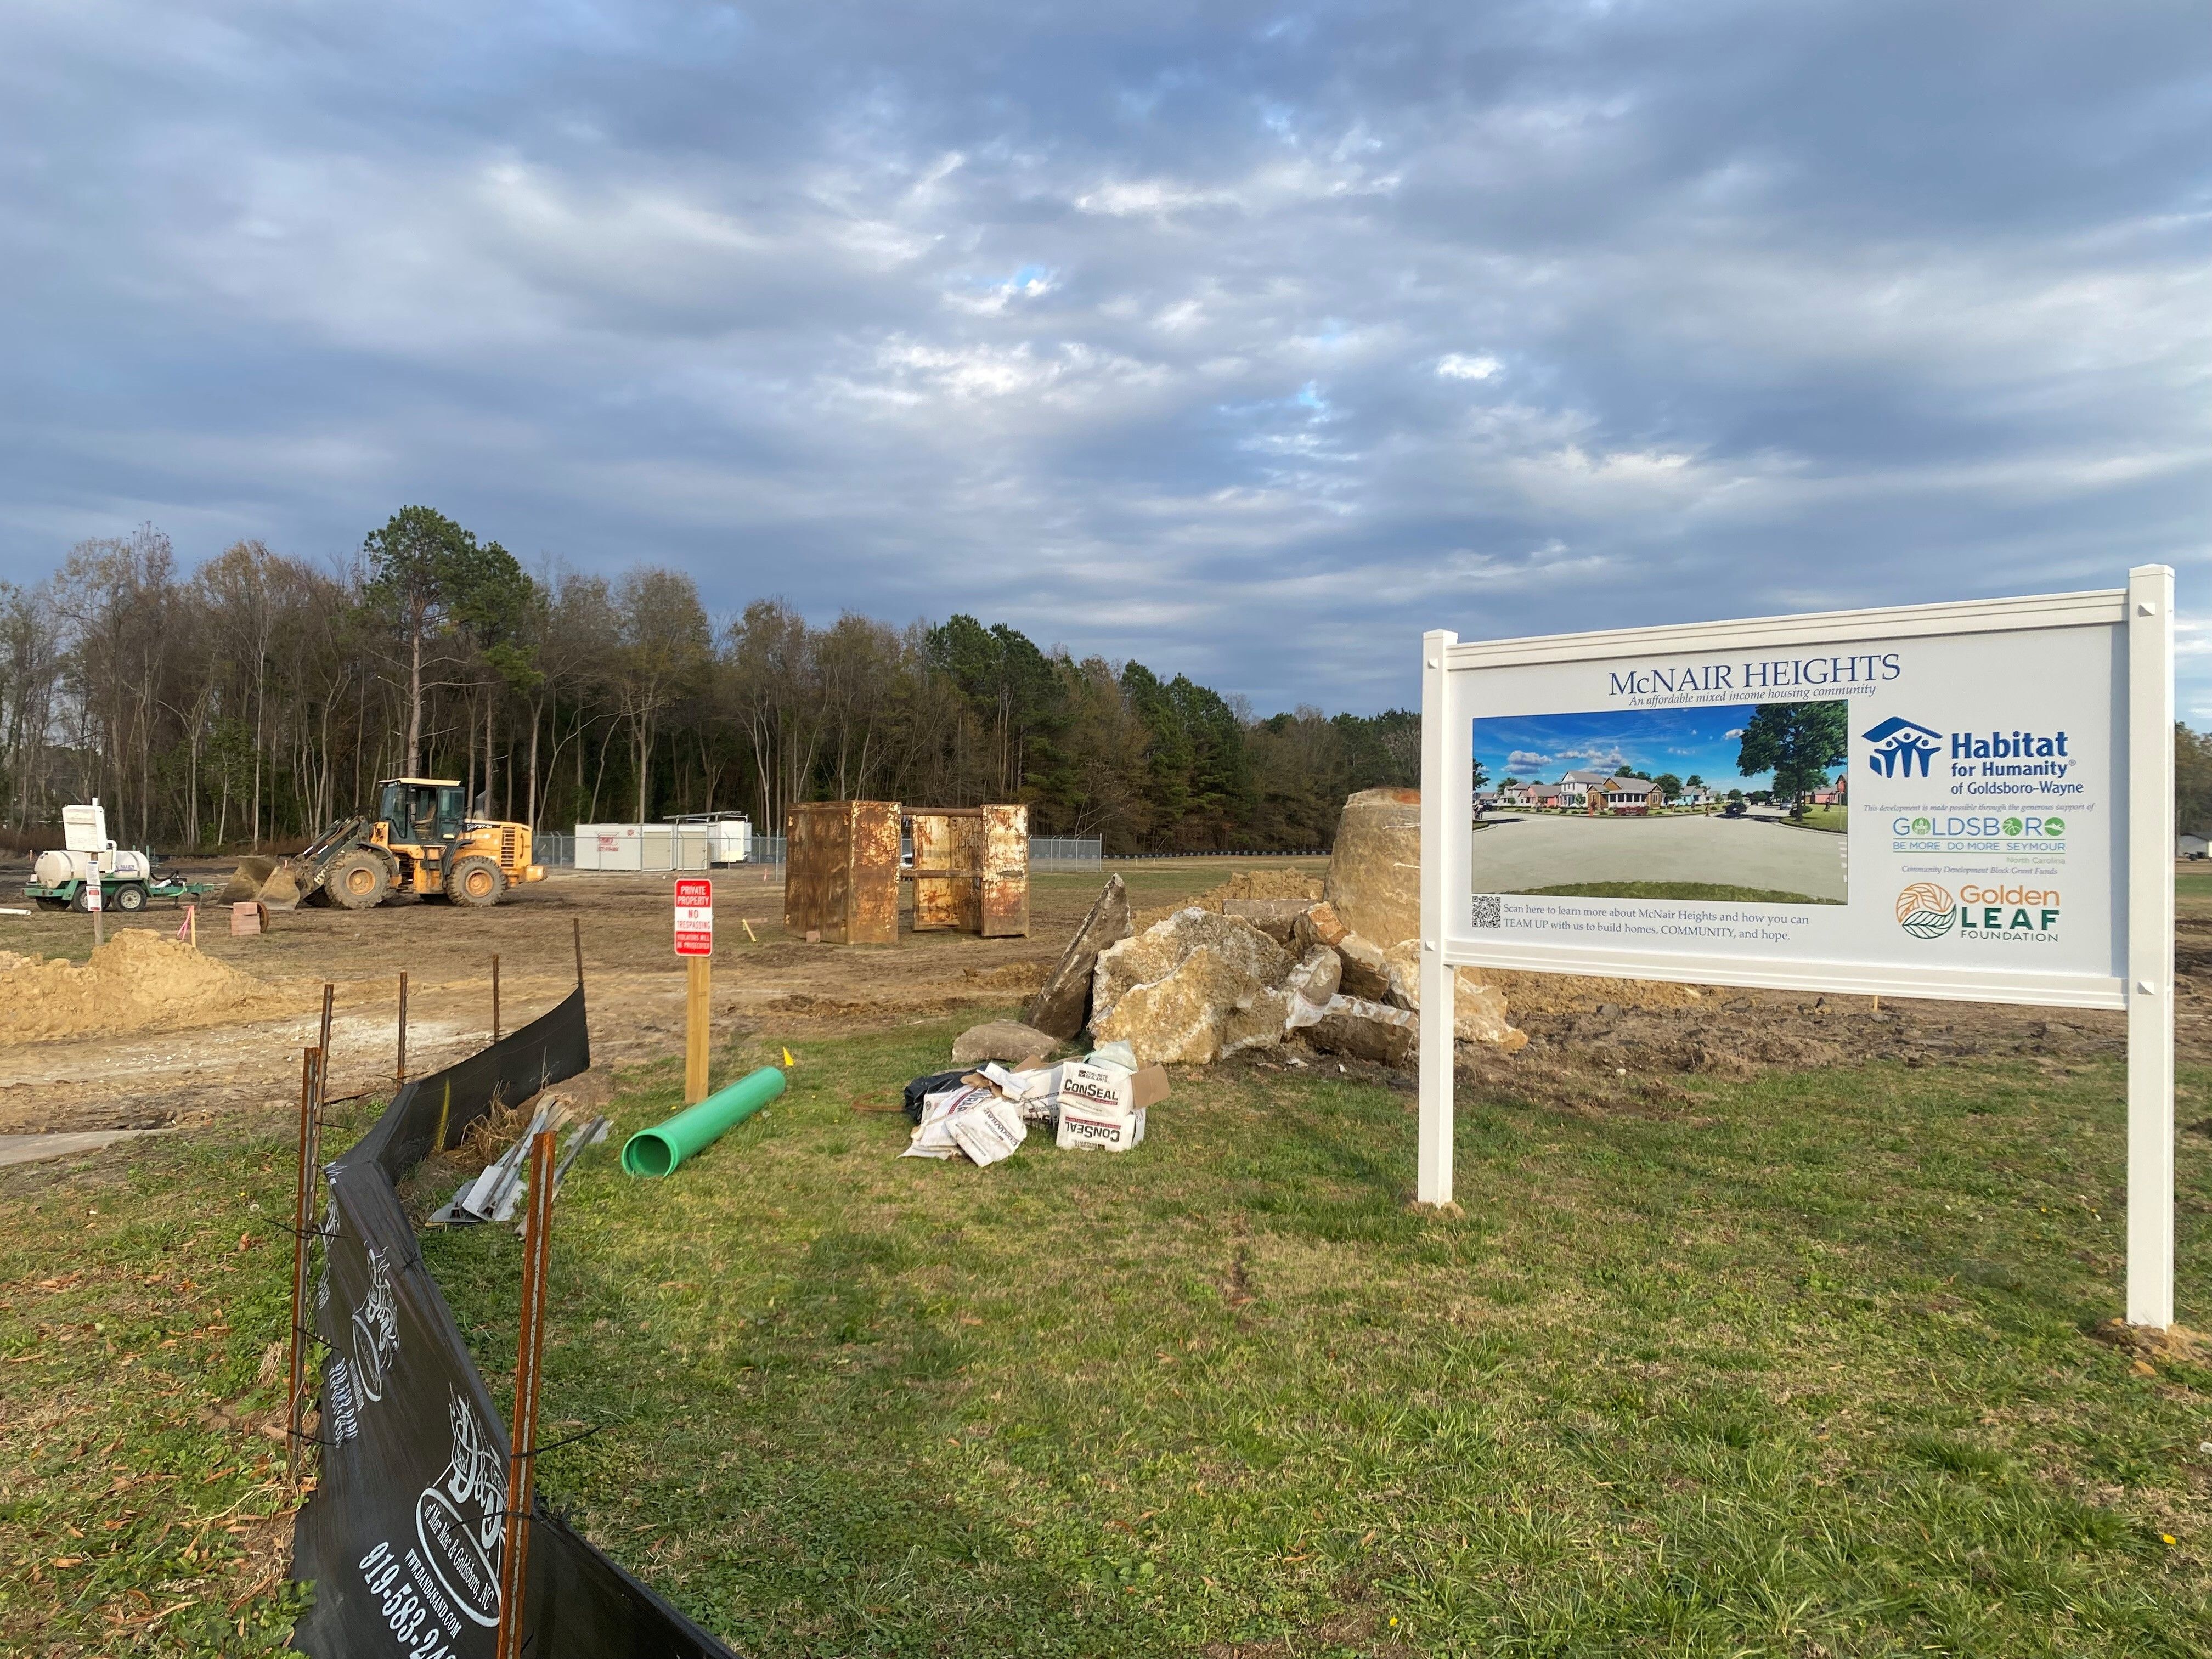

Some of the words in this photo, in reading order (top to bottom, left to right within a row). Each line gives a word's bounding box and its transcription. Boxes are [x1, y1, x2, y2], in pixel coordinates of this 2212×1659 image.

[1609, 665, 1734, 696] McNAIR
[1742, 653, 1901, 688] HEIGHTS
[1629, 695, 1644, 706] An
[1645, 693, 1694, 708] affordable
[1696, 691, 1726, 703] mixed
[1729, 690, 1765, 701] income
[1768, 687, 1810, 701] housing
[1813, 684, 1876, 697] community
[1951, 731, 2068, 759] Habitat
[1951, 763, 1976, 777] for
[1951, 782, 1963, 794] of
[1968, 781, 2083, 796] Goldsboro-Wayne
[1879, 804, 1920, 812] development
[1978, 804, 2006, 812] through
[2056, 804, 2085, 812] support
[2086, 803, 2096, 812] of
[1893, 817, 2066, 836] GOLDSBORO
[1968, 842, 2000, 850] MORE
[2007, 842, 2066, 851] SEYMOUR
[1901, 866, 1942, 874] Community
[1944, 866, 1988, 875] Development
[680, 885, 706, 895] PRIVATE
[1960, 884, 2060, 906] Golden
[677, 896, 710, 906] PROPERTY
[677, 921, 710, 929] TRESPASSING
[688, 910, 698, 919] NO
[1504, 904, 1523, 913] Scan
[1526, 905, 1544, 914] here
[1558, 906, 1581, 915] learn
[1583, 909, 1607, 917] more
[1609, 908, 1636, 918] about
[1639, 909, 1675, 919] McNair
[1678, 910, 1717, 923] Heights
[1720, 912, 1738, 922] and
[1742, 912, 1764, 923] how
[1768, 916, 1787, 926] you
[1790, 916, 1809, 924] can
[1962, 907, 2059, 930] LEAF
[1504, 918, 1532, 928] TEAM
[1535, 920, 1548, 929] UP
[1551, 920, 1570, 930] with
[1587, 923, 1595, 931] to
[1598, 922, 1622, 932] build
[1624, 923, 1658, 934] homes,
[1661, 925, 1736, 939] COMMUNITY,
[1739, 930, 1758, 940] and
[1761, 930, 1791, 943] hope.
[1961, 930, 2058, 942] FOUNDATION
[455, 1441, 470, 1475] Sand
[424, 1503, 436, 1519] of
[428, 1506, 442, 1534] Mar
[437, 1522, 451, 1550] Mac
[448, 1539, 459, 1559] &
[453, 1548, 481, 1600] Goldsboro,
[404, 1548, 462, 1639] WWW.DANDJSAND.COM
[478, 1583, 494, 1611] NC
